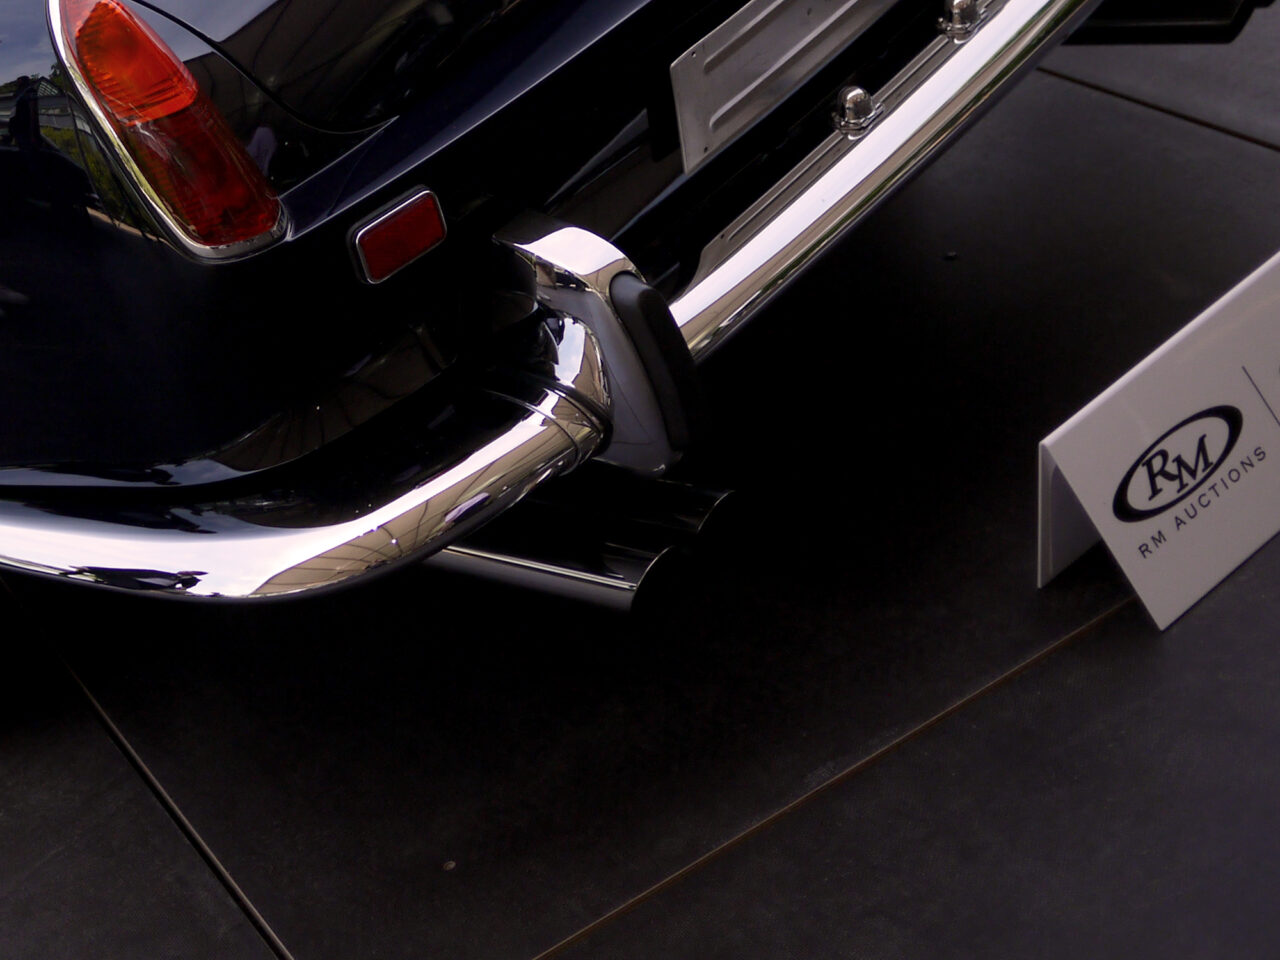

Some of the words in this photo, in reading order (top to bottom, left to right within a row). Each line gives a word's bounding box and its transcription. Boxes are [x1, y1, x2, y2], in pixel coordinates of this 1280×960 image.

[1138, 530, 1167, 559] RM
[1174, 446, 1266, 530] AUCTIONS
[1141, 434, 1214, 501] RM
